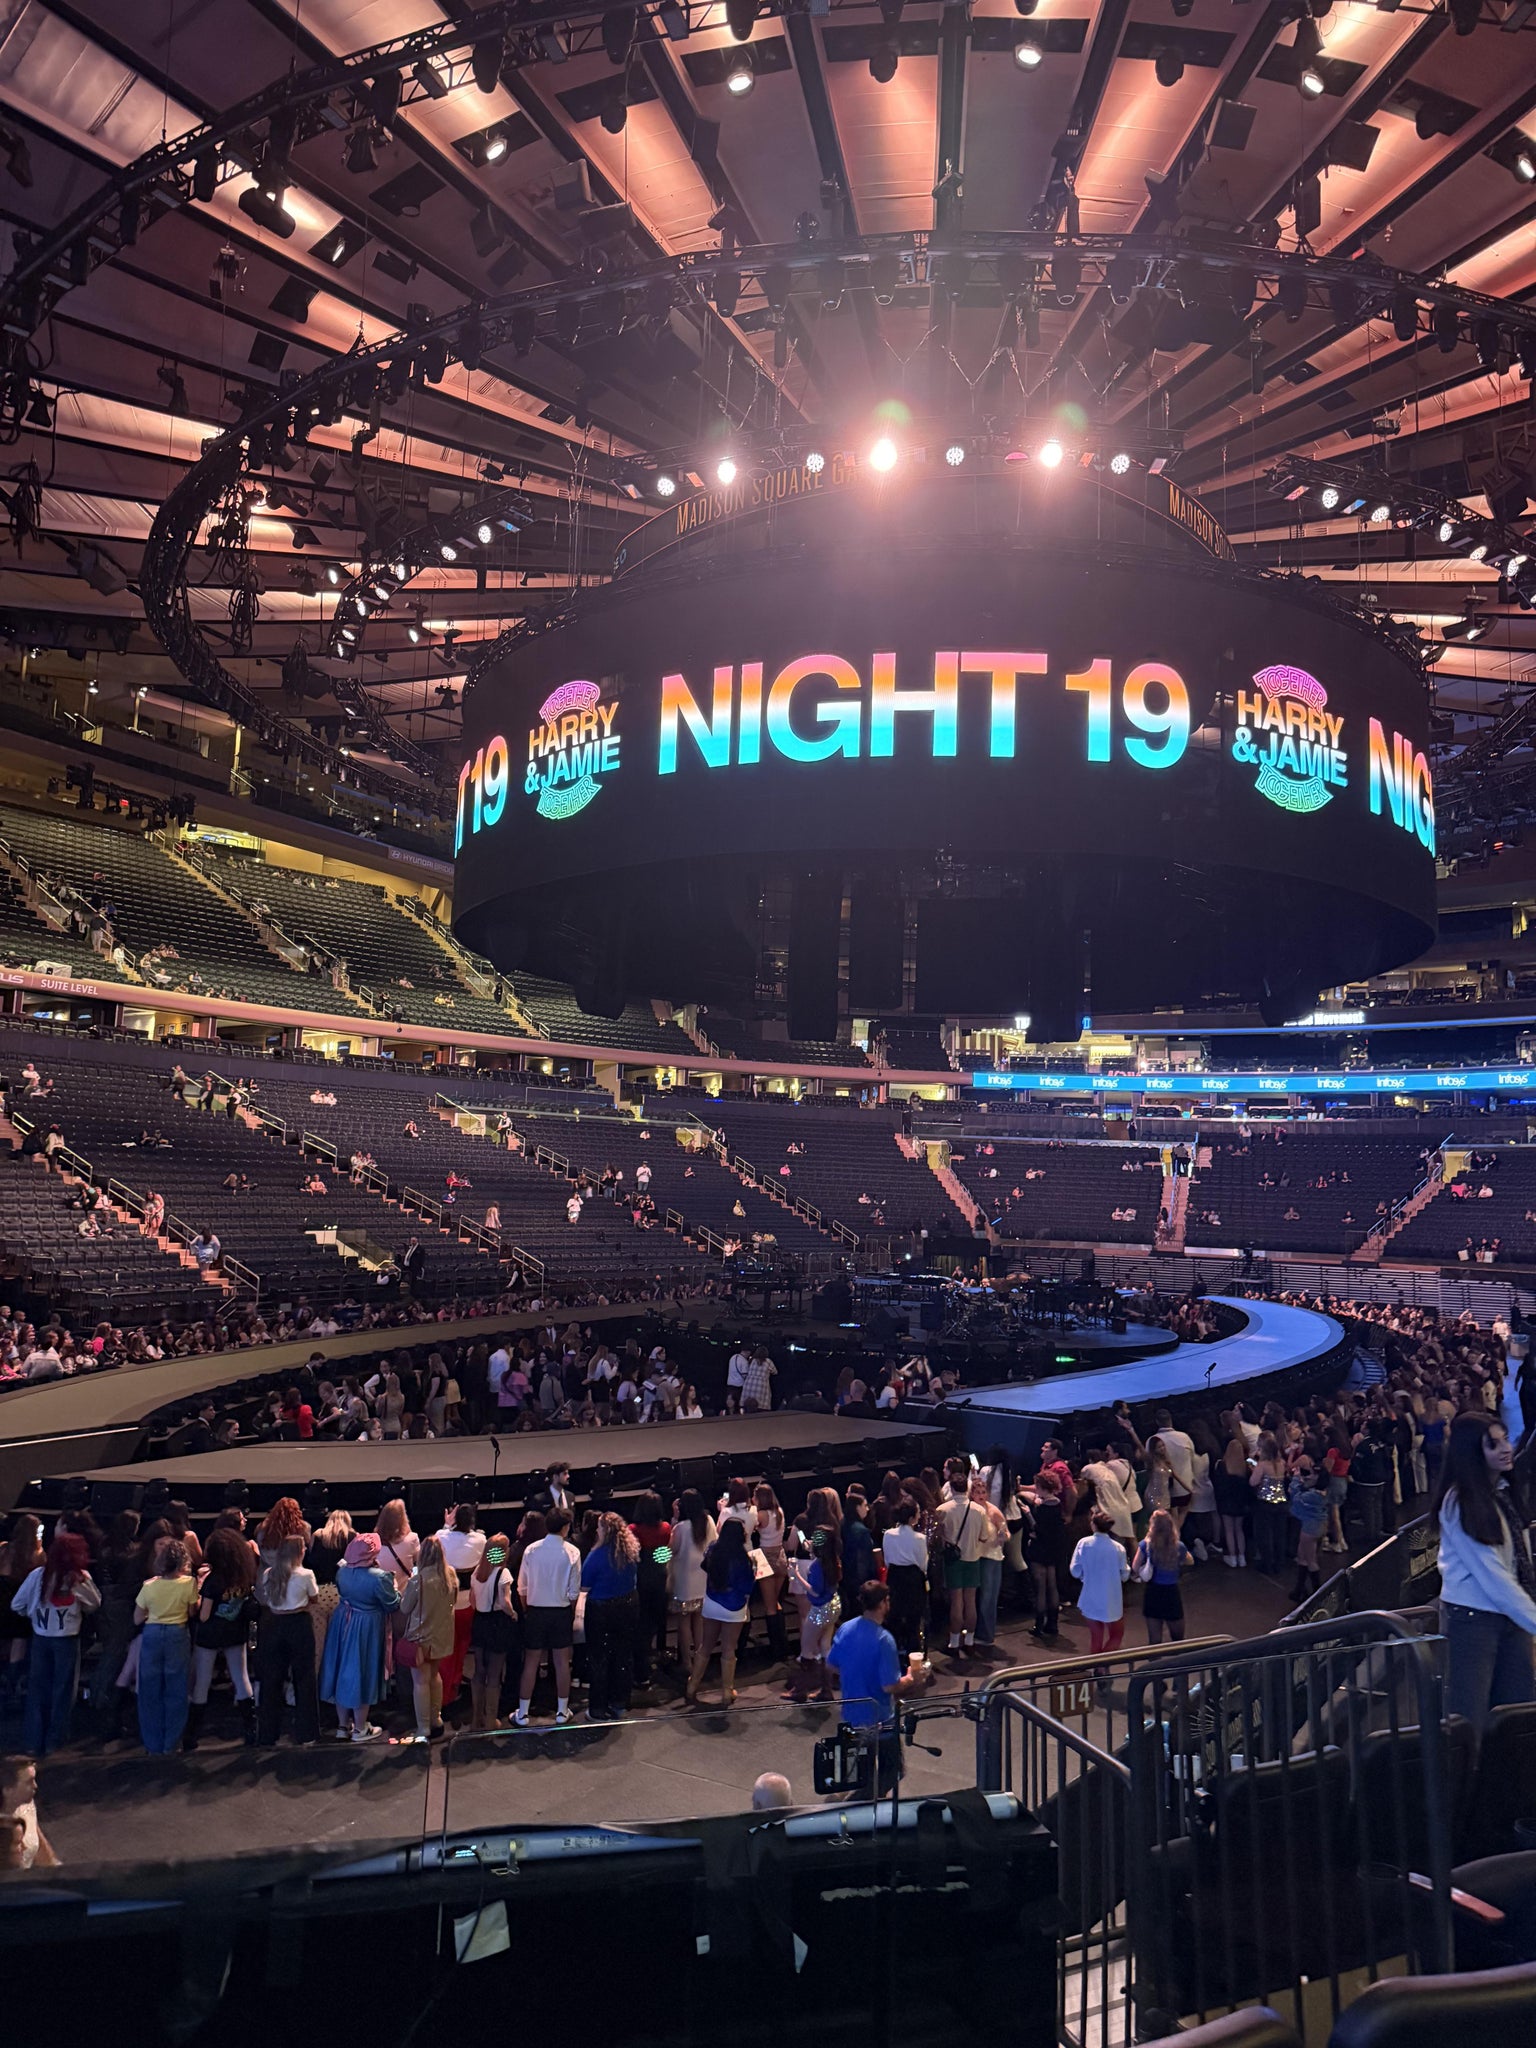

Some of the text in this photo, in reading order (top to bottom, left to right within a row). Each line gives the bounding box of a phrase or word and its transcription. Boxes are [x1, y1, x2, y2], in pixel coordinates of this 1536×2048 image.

[676, 480, 746, 535] MADISON
[752, 465, 824, 505] SQUARE
[1169, 483, 1214, 547] MADISON
[529, 701, 620, 761] HARRY
[658, 651, 1190, 775] NIGHT 19
[1237, 690, 1345, 750] HARRY
[470, 734, 509, 834] 19
[402, 853, 434, 868] HYUNDAI
[41, 979, 69, 991] SUITE
[70, 983, 99, 995] LEVEL
[36, 1607, 69, 1631] NY
[1056, 1682, 1091, 1712] 114
